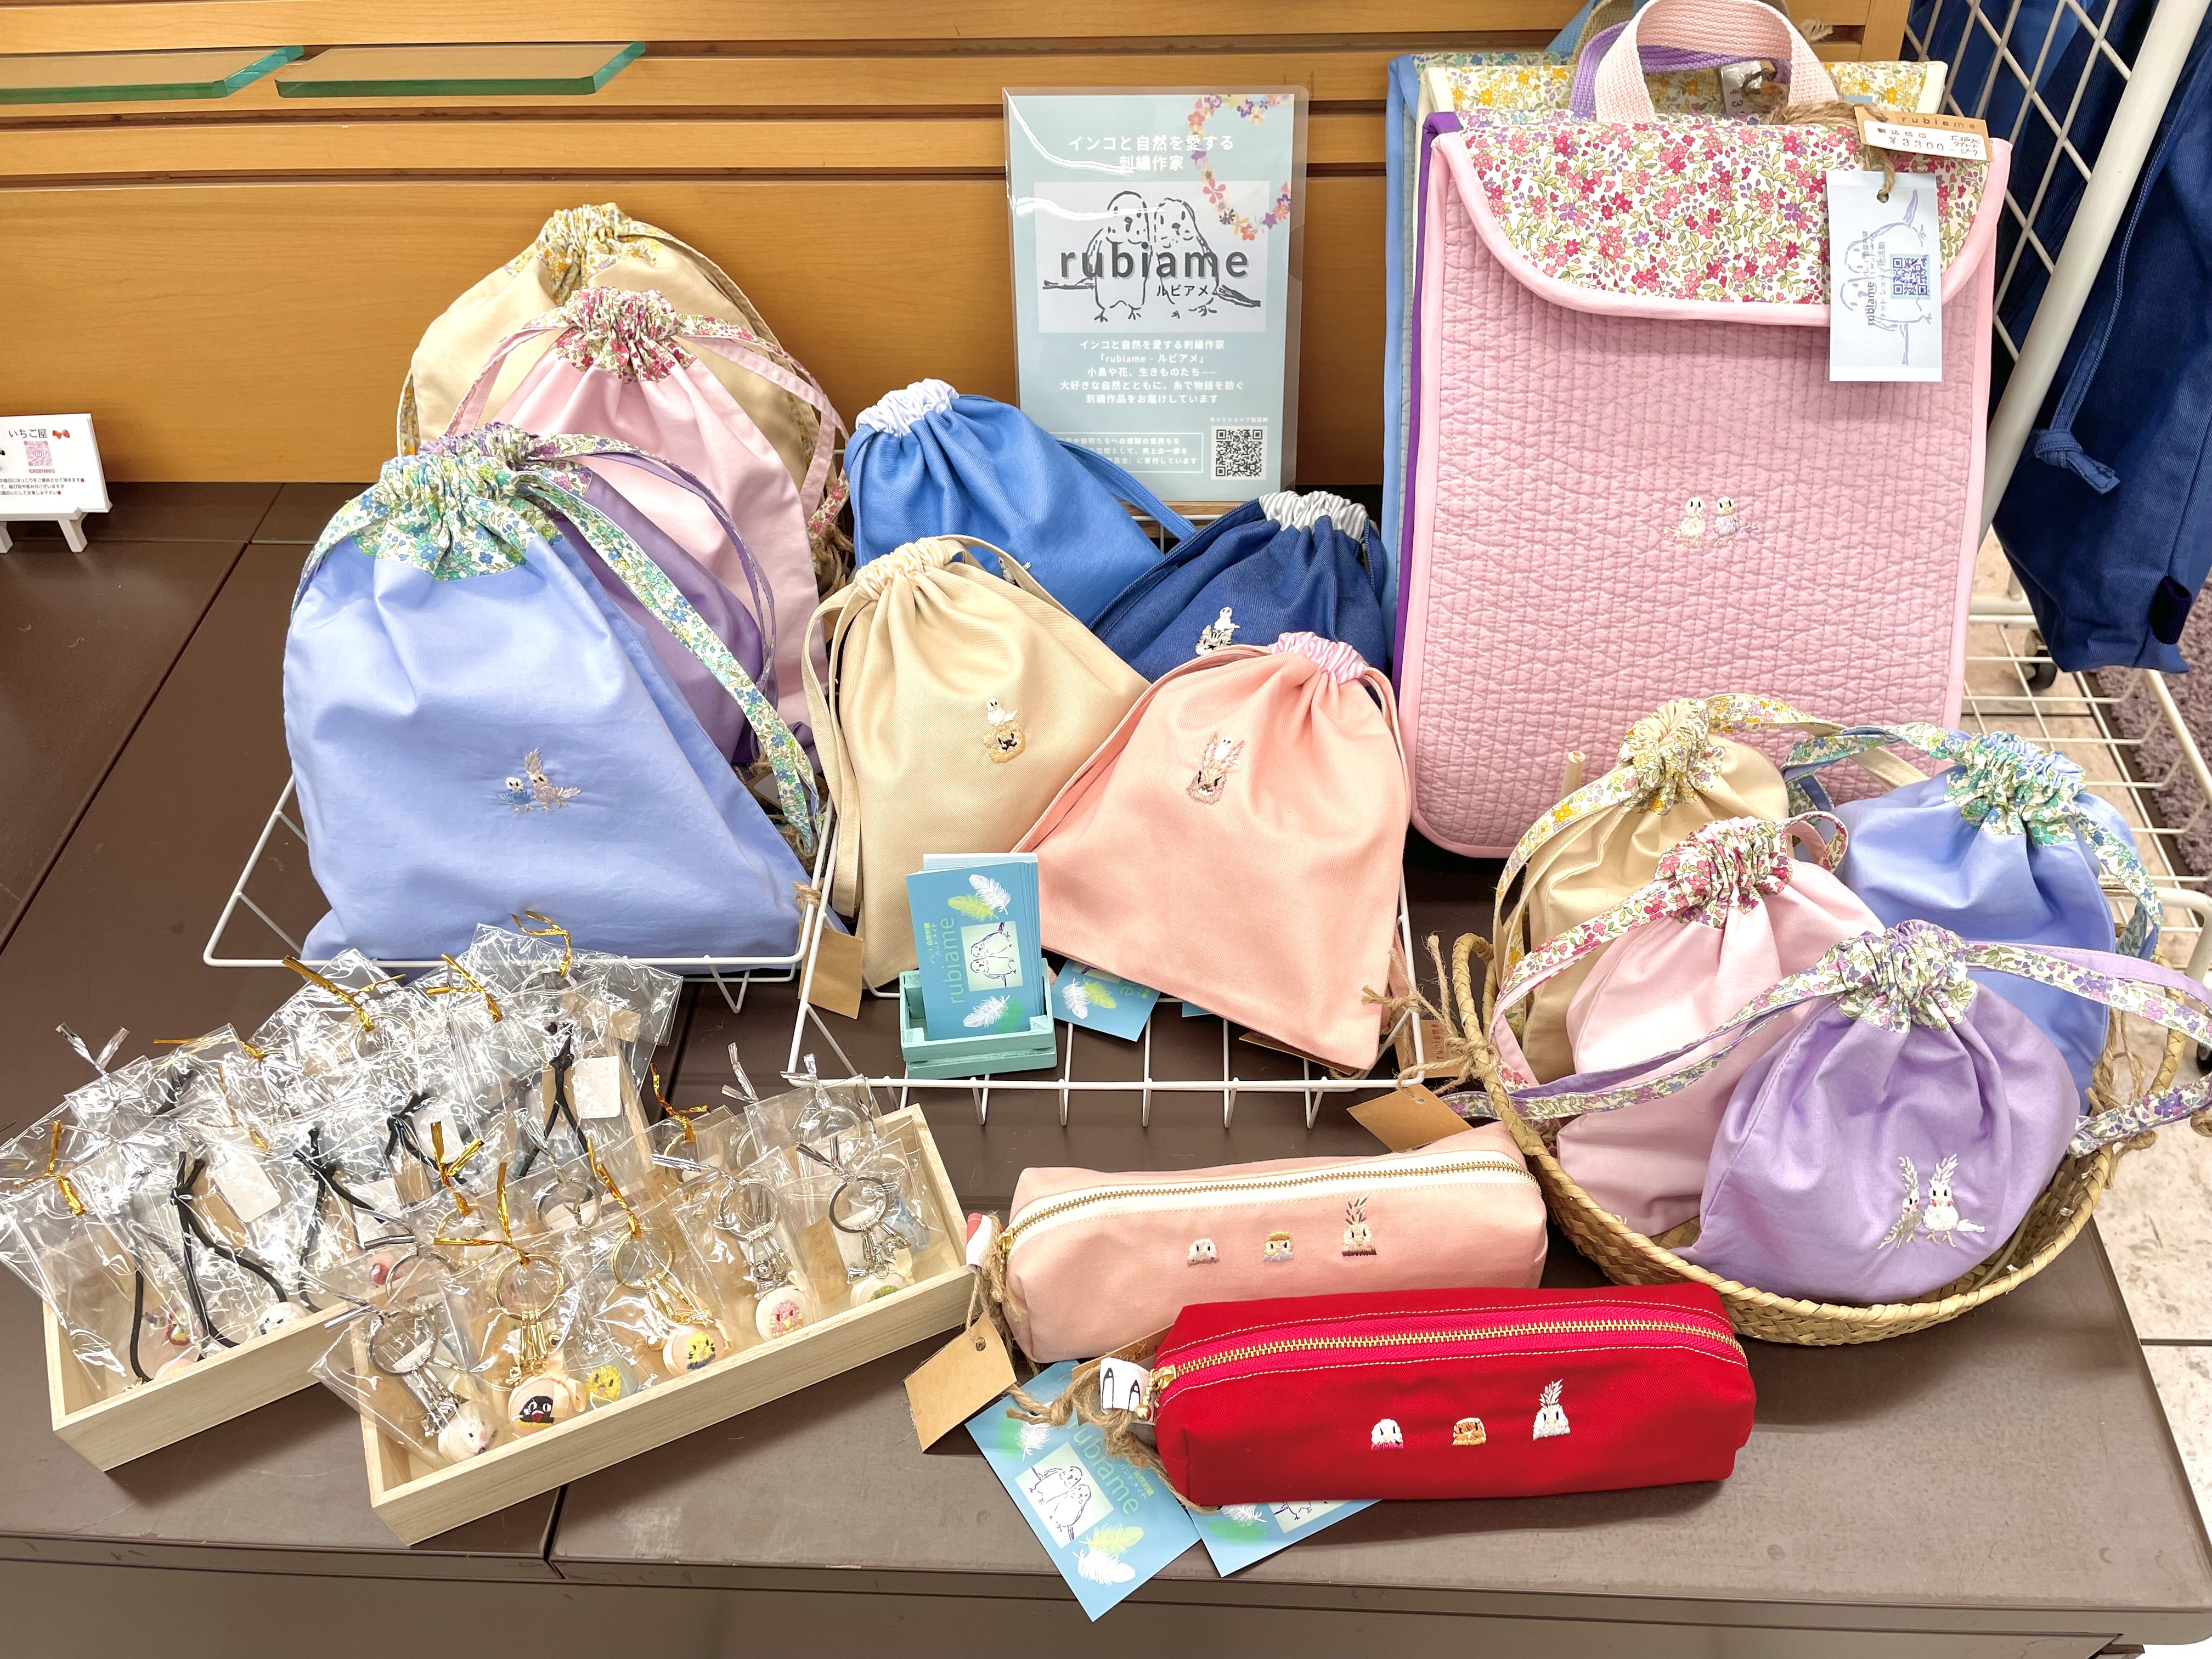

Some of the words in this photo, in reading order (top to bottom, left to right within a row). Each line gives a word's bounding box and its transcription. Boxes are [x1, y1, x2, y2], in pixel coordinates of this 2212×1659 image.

[1901, 116, 1976, 129] rubiame
[1069, 134, 1234, 151] インコと自然を愛する
[1118, 155, 1184, 171] 刺繍作家
[1060, 241, 1249, 279] rubiame
[1156, 285, 1210, 297] ルビアメ
[1865, 281, 1875, 325] rubiame
[1079, 340, 1226, 350] インコと自然を愛する刺繍作家
[1085, 394, 1220, 404] 刺繍作品をお届けしています
[940, 917, 966, 1004] rubiame
